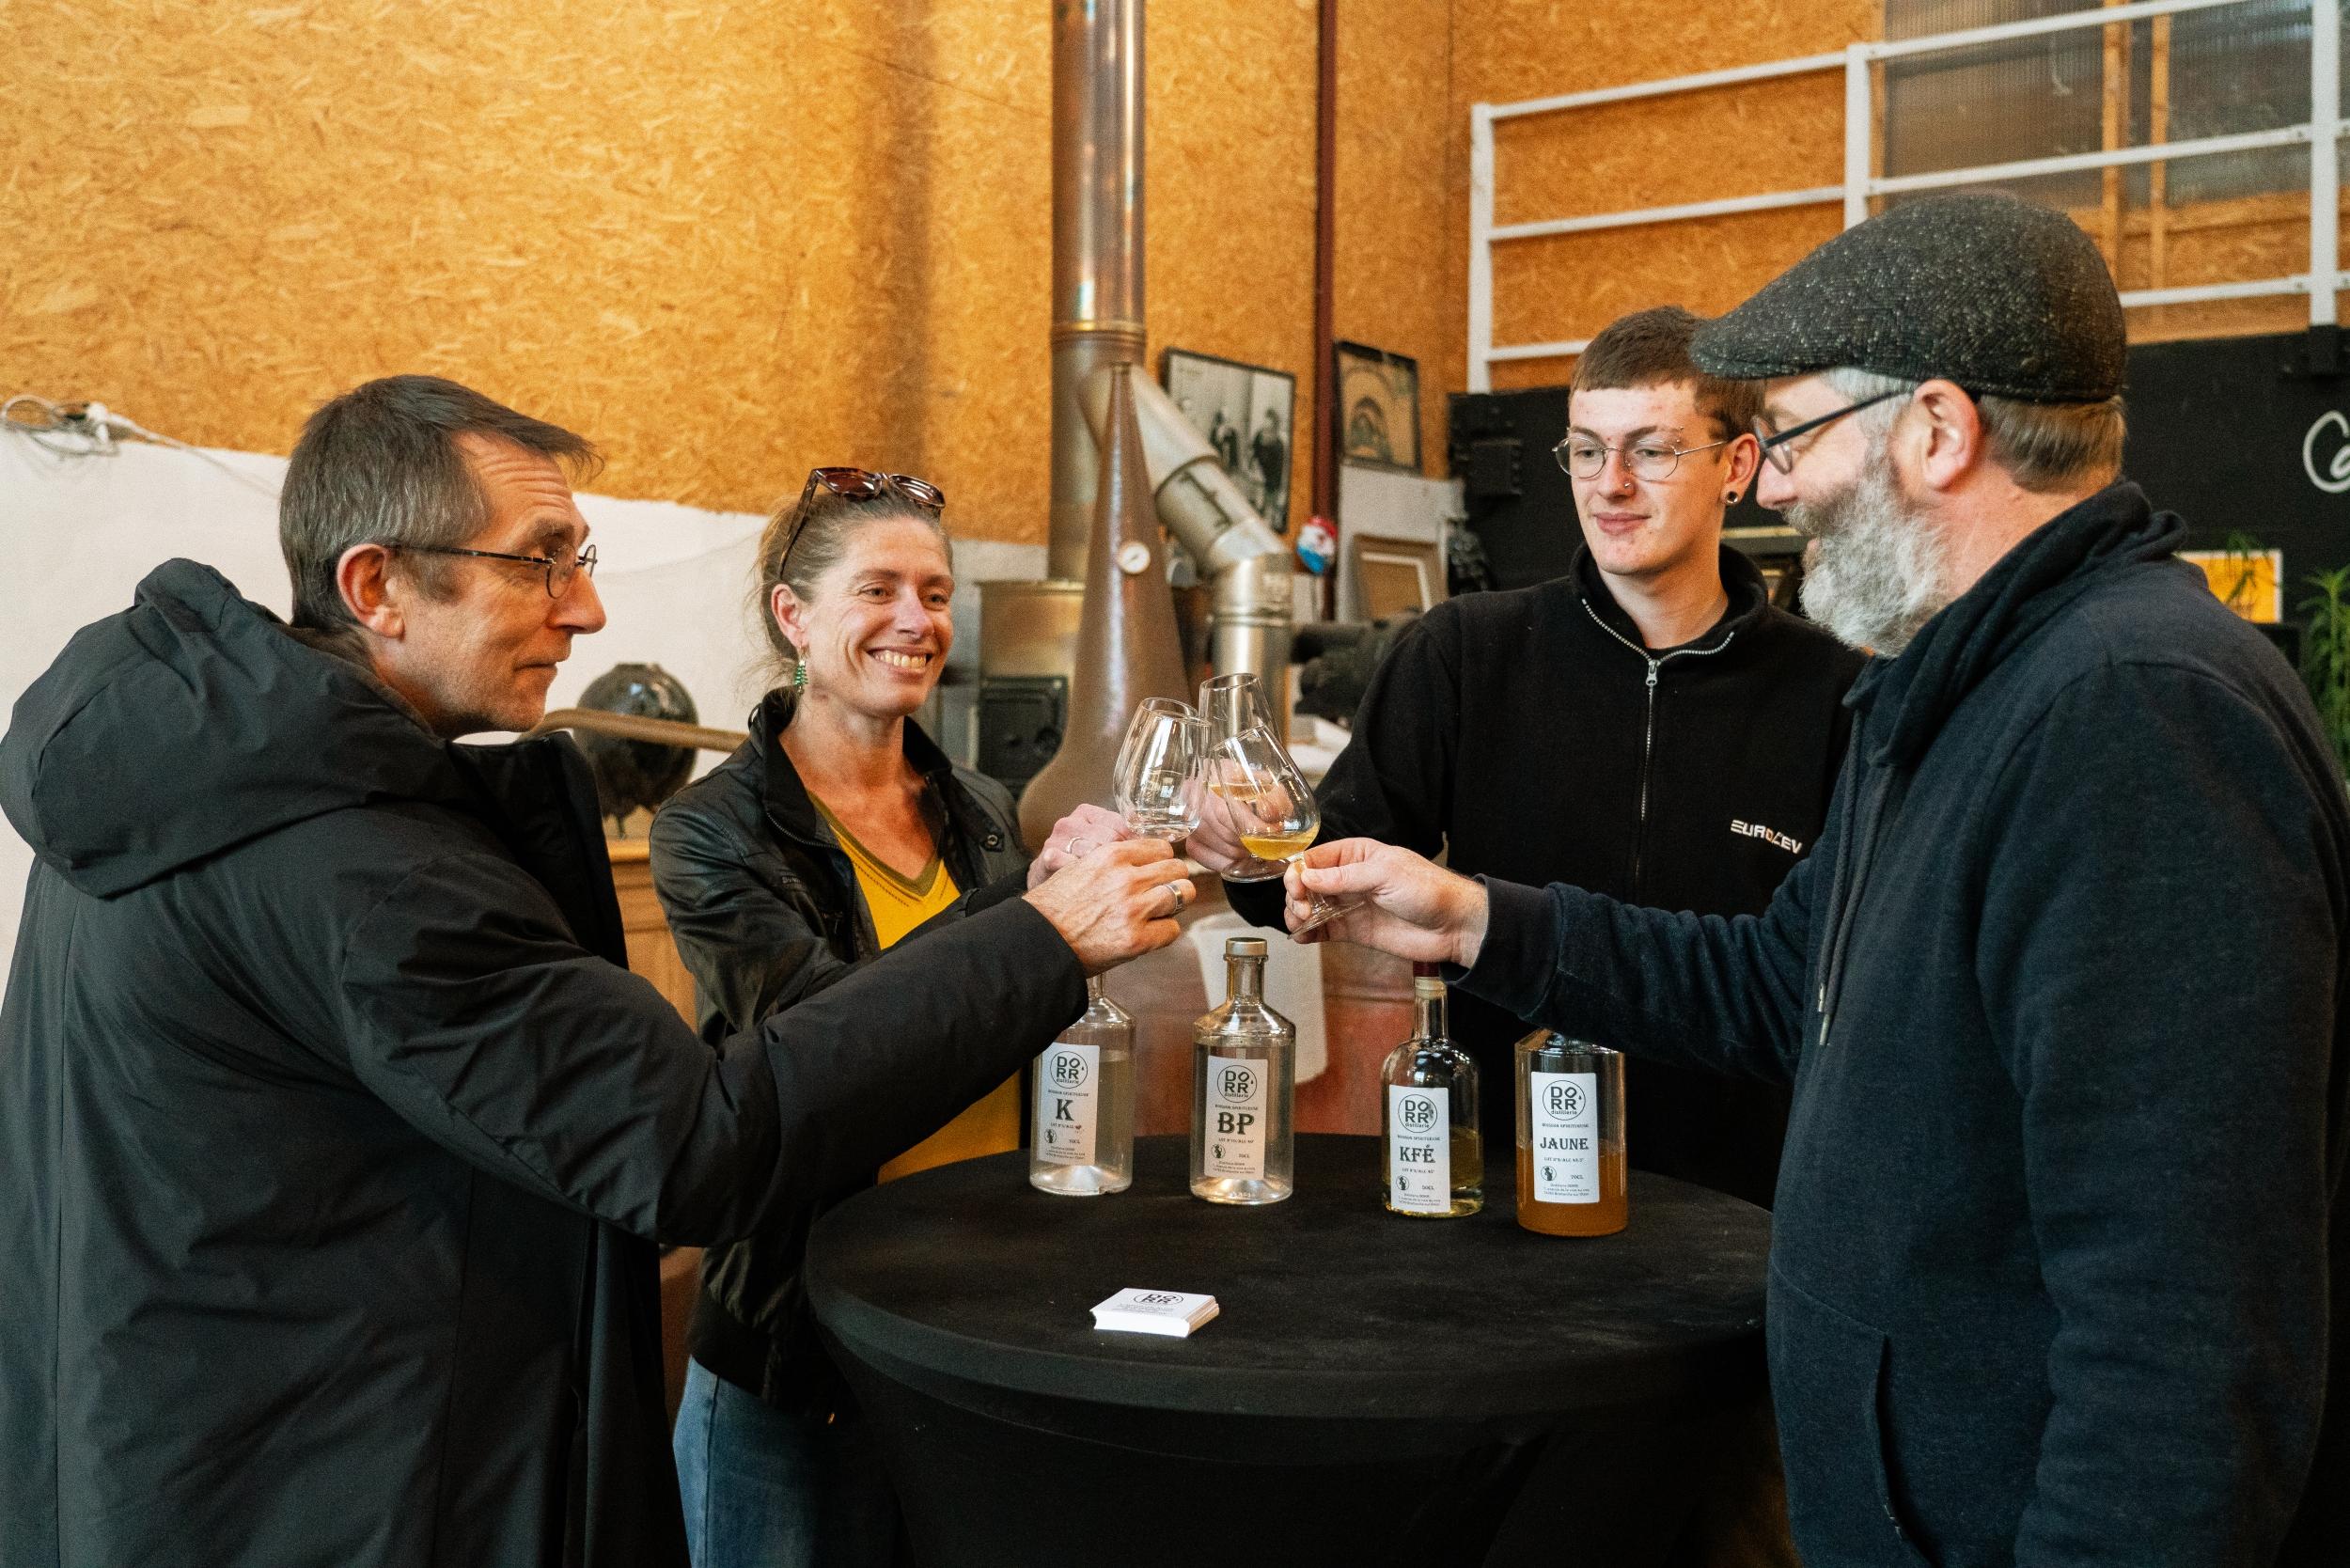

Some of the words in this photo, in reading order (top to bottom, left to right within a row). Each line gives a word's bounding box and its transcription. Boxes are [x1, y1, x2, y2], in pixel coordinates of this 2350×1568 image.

[1056, 1098, 1074, 1121] K
[1217, 1111, 1255, 1136] BP
[1400, 1144, 1436, 1164] KFÉ
[1540, 1137, 1590, 1151] JAUNE
